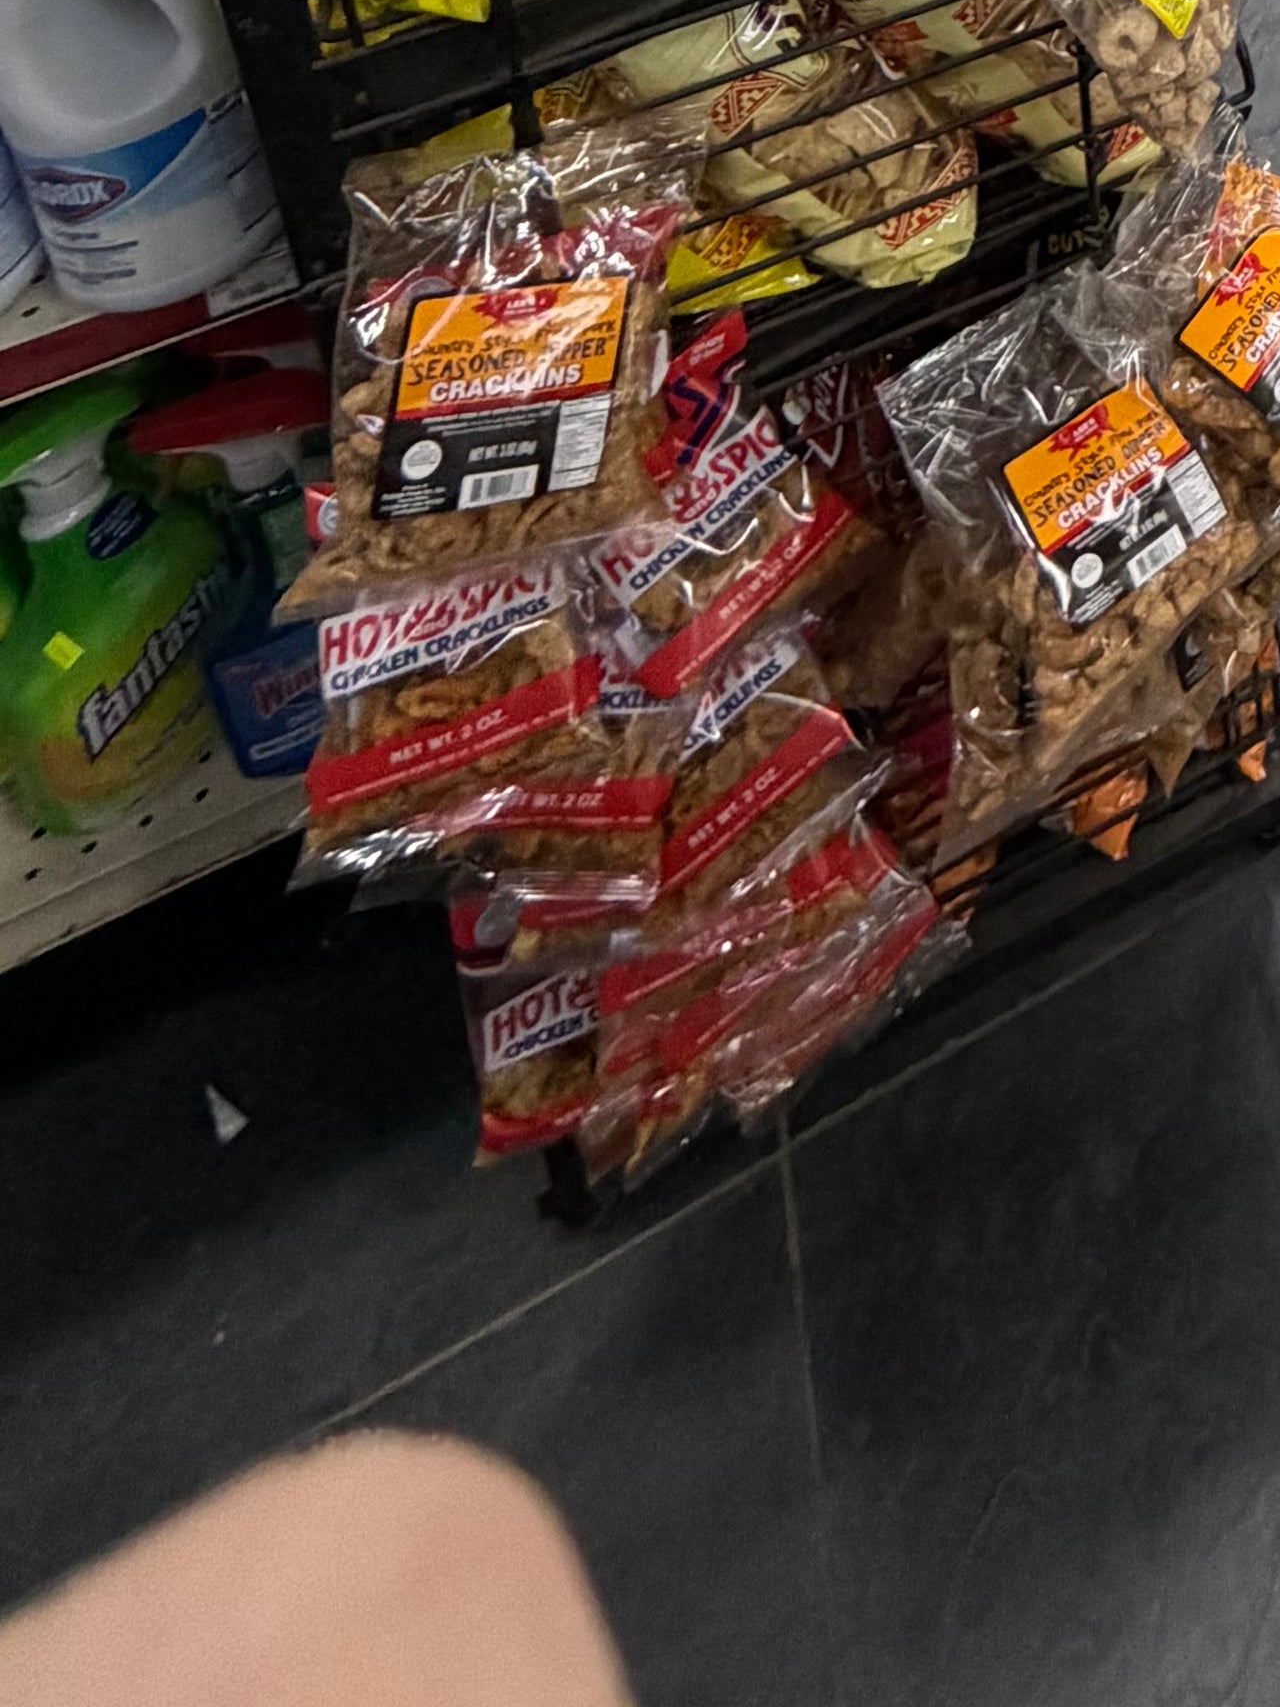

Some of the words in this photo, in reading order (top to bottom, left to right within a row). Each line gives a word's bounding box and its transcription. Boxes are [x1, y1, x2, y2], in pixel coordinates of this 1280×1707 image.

[1057, 445, 1164, 530] CRACKLINS
[323, 608, 406, 673] HOT
[423, 595, 552, 659] CRACKLINGS
[489, 974, 567, 1054] HOT
